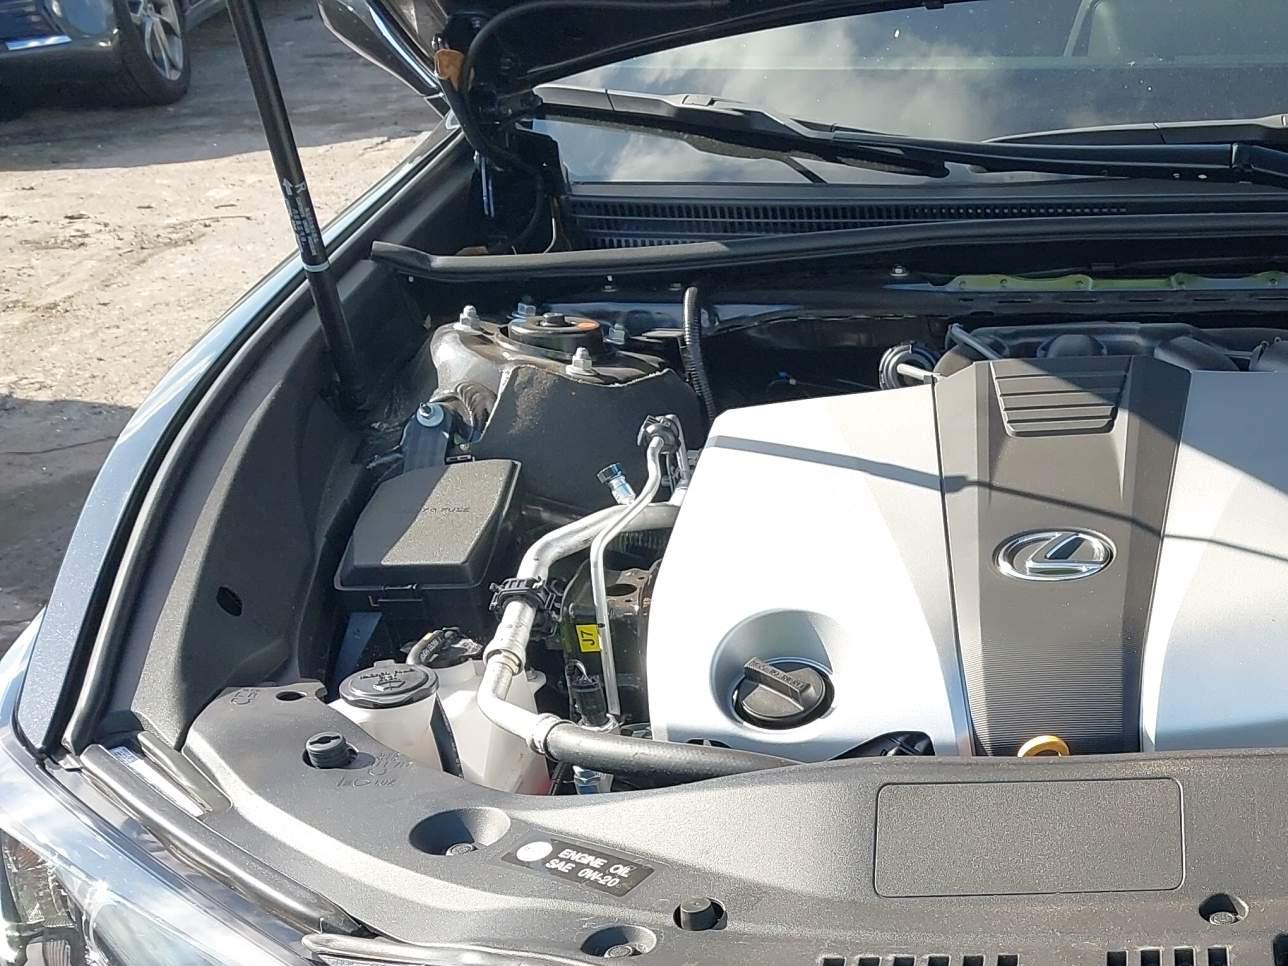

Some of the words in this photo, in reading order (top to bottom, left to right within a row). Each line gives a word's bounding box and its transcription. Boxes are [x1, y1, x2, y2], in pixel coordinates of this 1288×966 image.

[580, 630, 595, 646] J7
[545, 859, 575, 874] SAE
[577, 868, 620, 887] 0W-20
[558, 849, 608, 868] ENGINE
[609, 864, 632, 878] OIL
